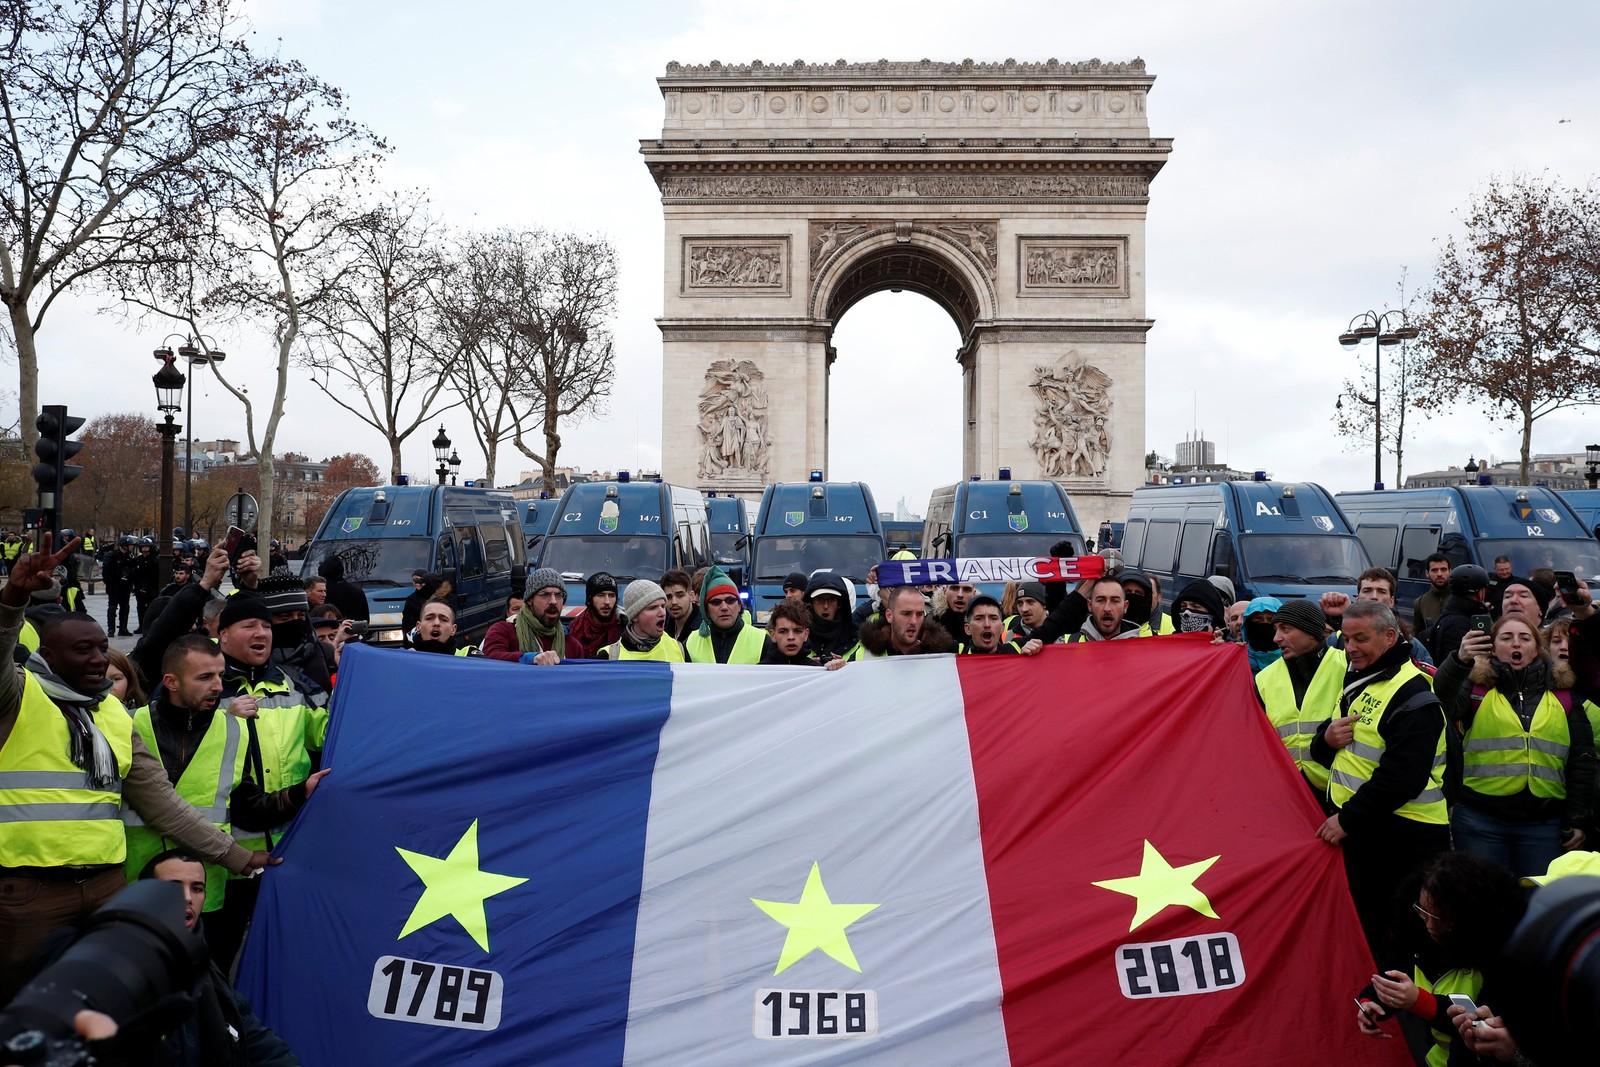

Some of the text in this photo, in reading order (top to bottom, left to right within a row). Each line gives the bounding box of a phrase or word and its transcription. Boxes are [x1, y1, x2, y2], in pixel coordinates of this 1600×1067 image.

[969, 509, 989, 520] C1
[1047, 511, 1066, 519] 14/7
[1256, 501, 1282, 516] A1
[563, 512, 582, 522] C2
[640, 514, 660, 522] 14/7
[1526, 525, 1545, 537] A2
[901, 557, 1081, 584] FRANCE
[1123, 937, 1236, 995] 2018
[382, 959, 493, 1024] 1789
[762, 992, 866, 1036] 1968
